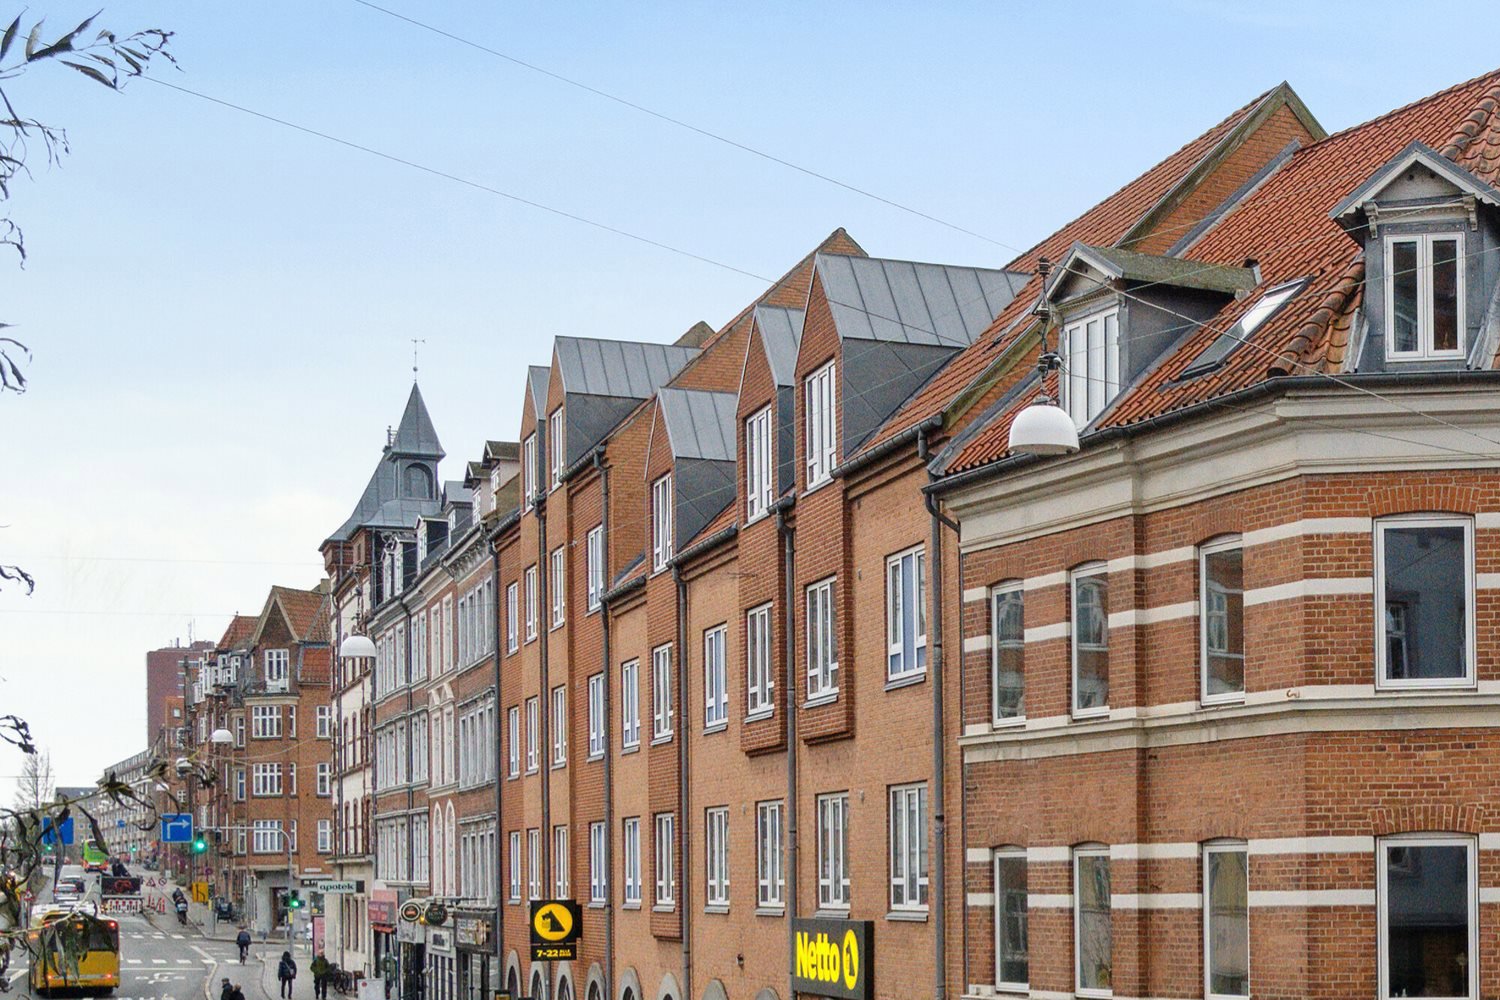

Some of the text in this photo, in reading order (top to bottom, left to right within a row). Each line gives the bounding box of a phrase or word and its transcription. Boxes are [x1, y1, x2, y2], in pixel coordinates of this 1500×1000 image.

[320, 883, 354, 892] apotek
[536, 949, 559, 958] 7-22
[796, 931, 841, 984] Netto
